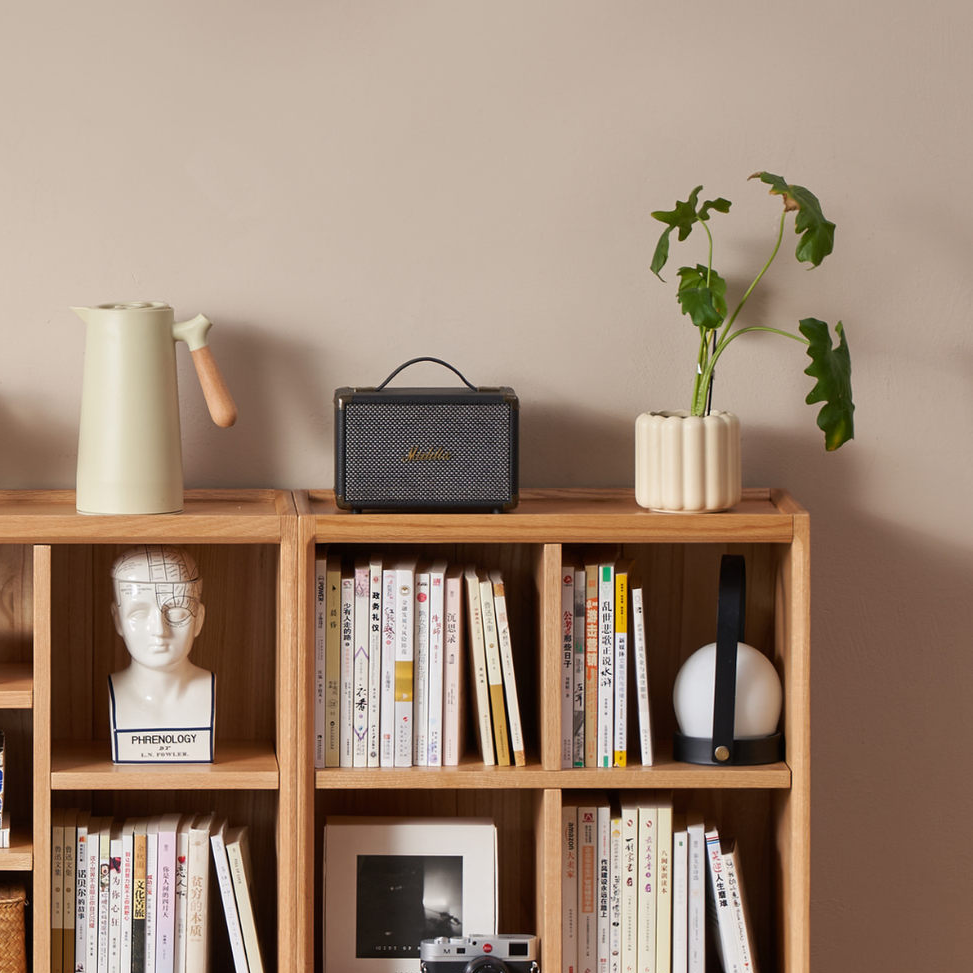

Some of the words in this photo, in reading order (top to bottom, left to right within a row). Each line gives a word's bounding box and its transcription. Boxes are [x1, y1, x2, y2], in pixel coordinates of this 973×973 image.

[343, 603, 352, 641] 少有人走的路
[372, 591, 380, 632] 政务礼仪
[447, 613, 456, 644] 沉思录
[131, 733, 197, 744] PHRENOLOGY
[54, 845, 62, 877] 鲁迅文集
[65, 845, 73, 877] 鲁迅文集
[567, 851, 575, 878] 大卖家
[77, 869, 87, 920] 诺贝尔的故事
[111, 876, 120, 927] 为你心狂
[134, 880, 145, 918] 文化苦旅
[190, 875, 203, 937] 贫穷的本质
